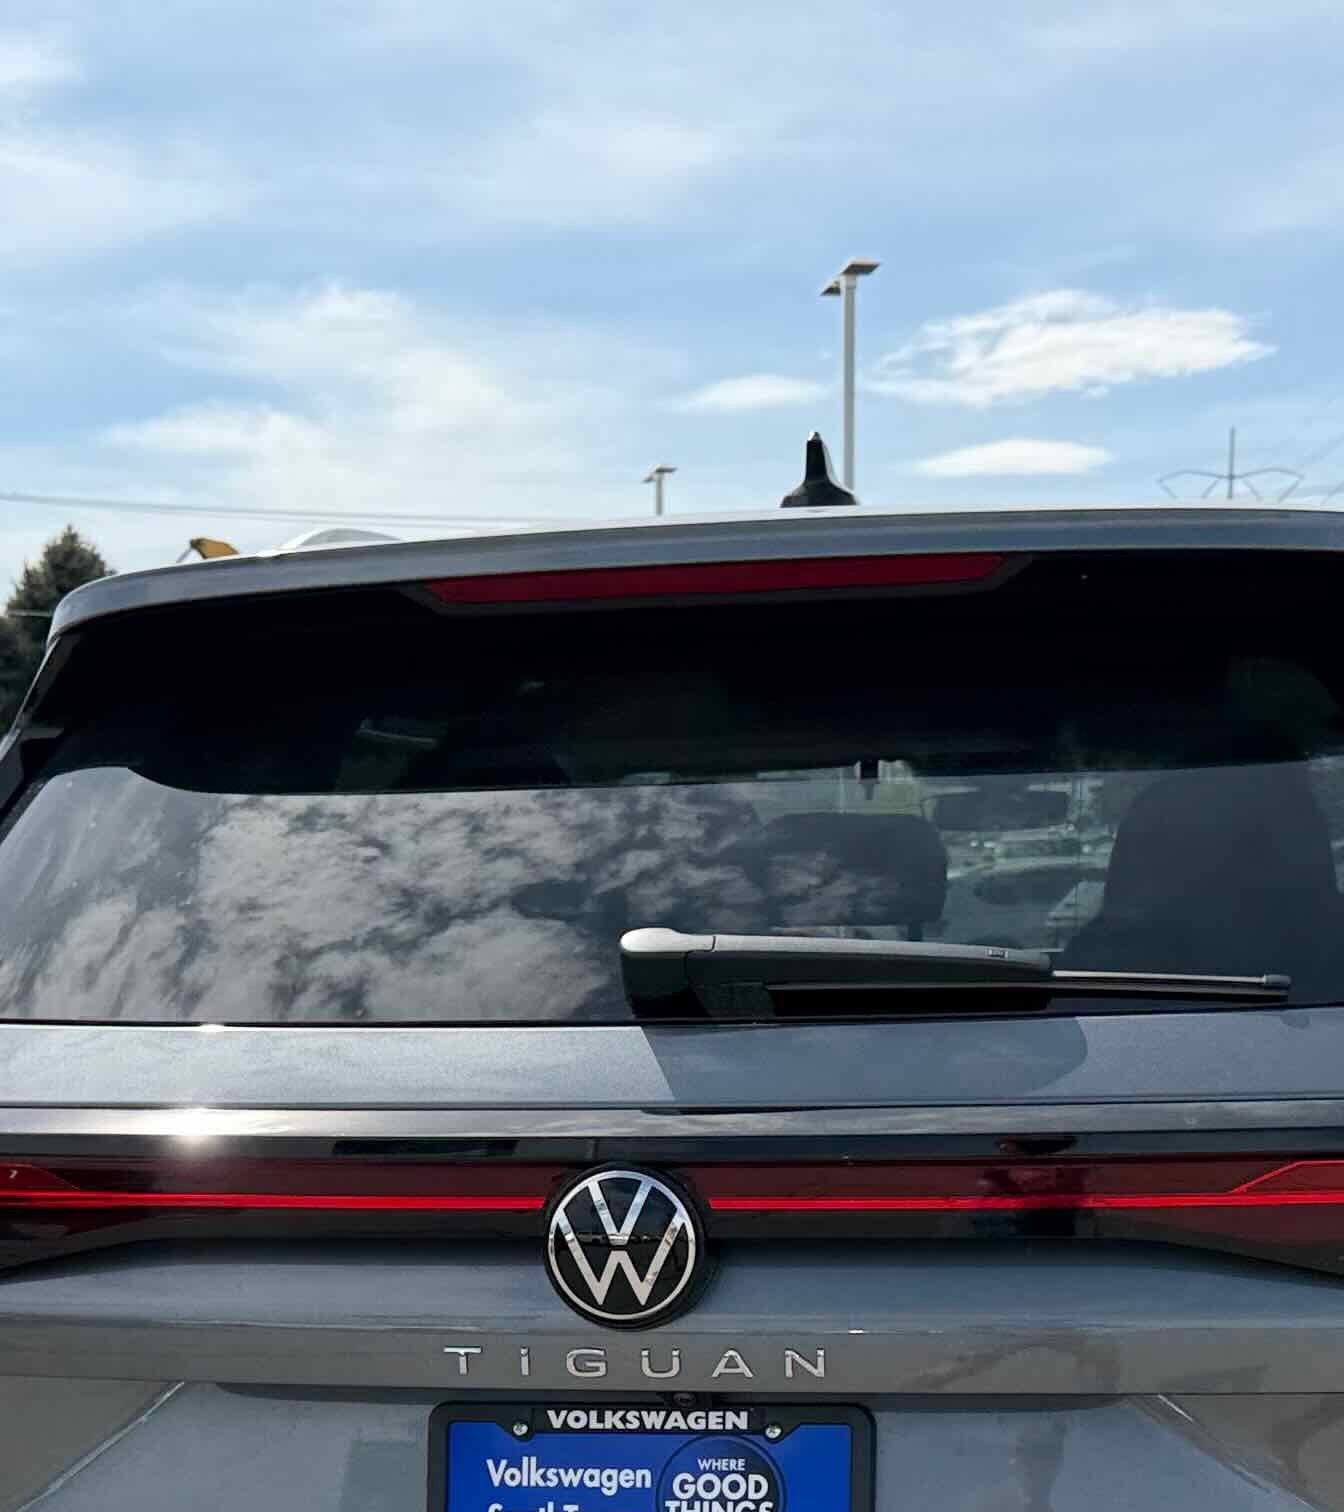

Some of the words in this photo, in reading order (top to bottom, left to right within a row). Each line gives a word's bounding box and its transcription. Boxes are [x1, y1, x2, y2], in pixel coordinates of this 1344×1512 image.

[444, 1346, 825, 1378] TIGUAN
[546, 1409, 748, 1430] VOLKSWAGEN
[486, 1456, 652, 1496] Volkswagen
[697, 1458, 746, 1472] WHERE
[672, 1472, 769, 1501] GOOD
